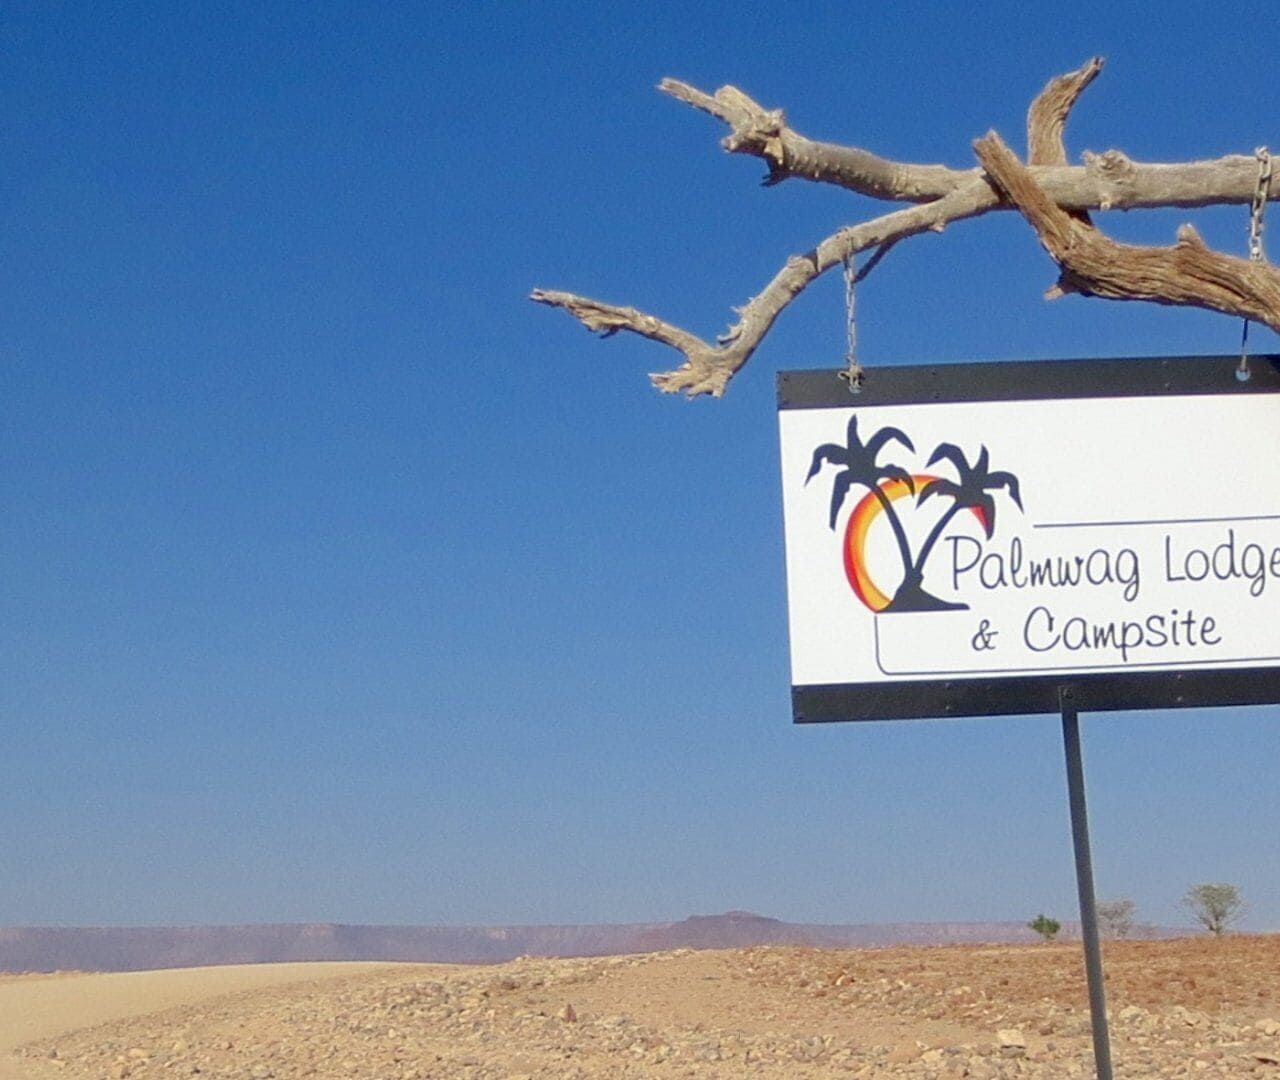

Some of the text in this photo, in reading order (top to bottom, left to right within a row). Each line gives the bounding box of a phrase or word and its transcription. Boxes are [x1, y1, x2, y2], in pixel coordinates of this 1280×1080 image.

[945, 534, 1141, 602] Palmwag
[971, 606, 1222, 662] & Campsite
